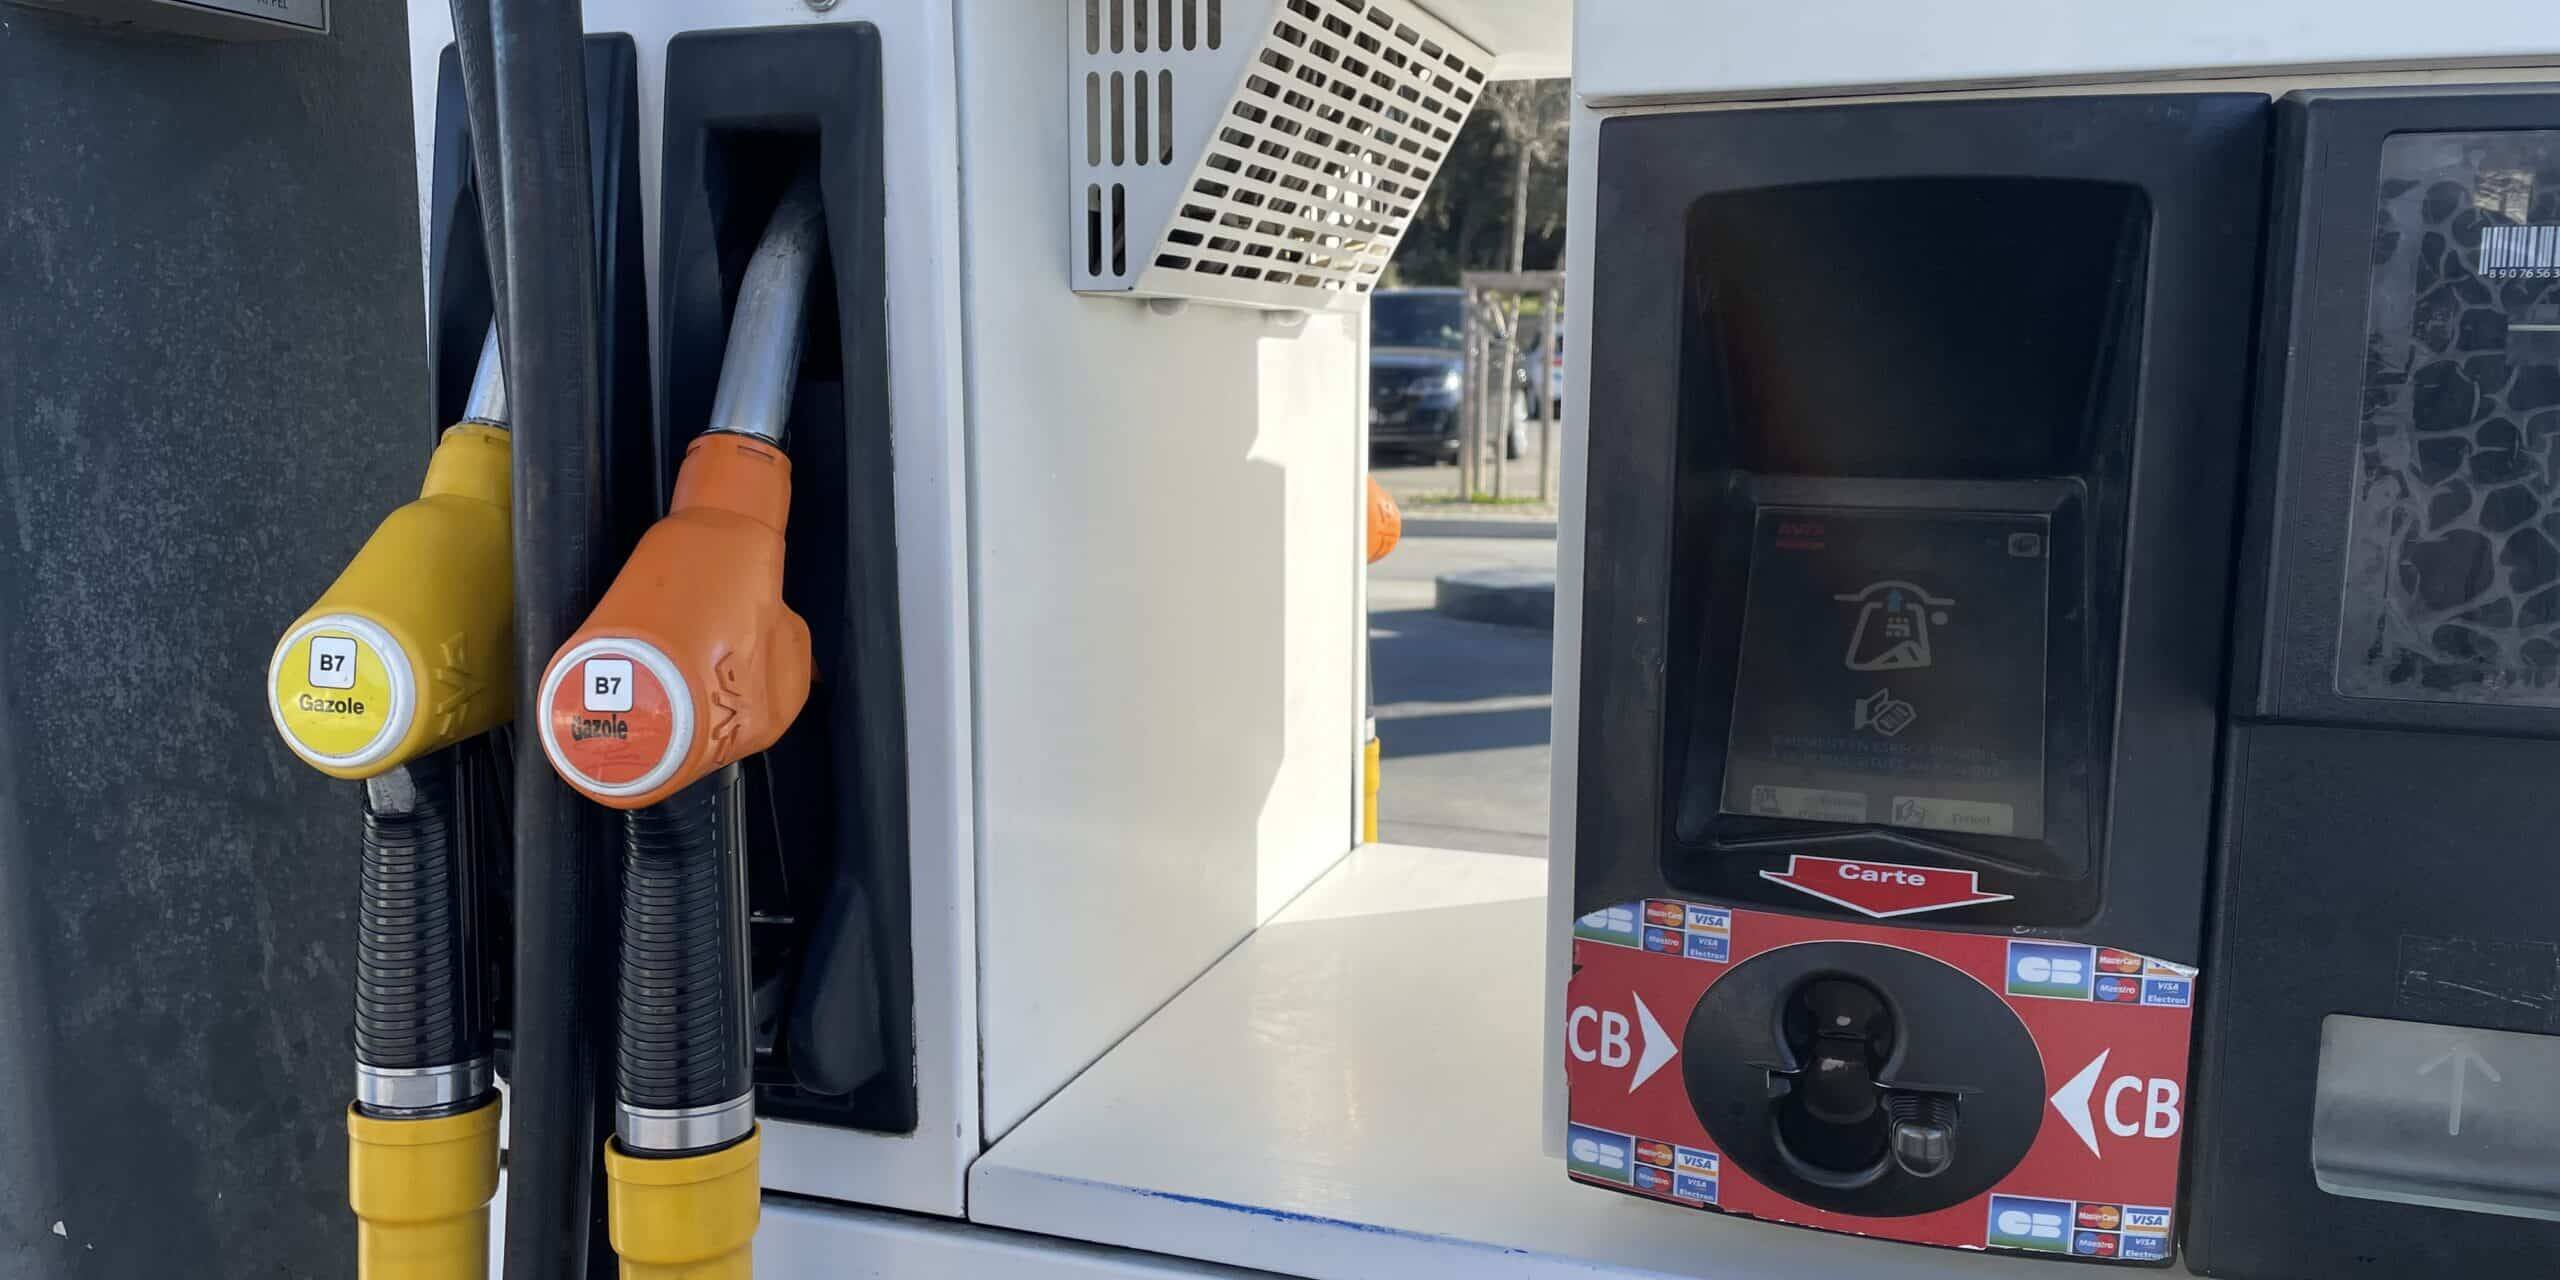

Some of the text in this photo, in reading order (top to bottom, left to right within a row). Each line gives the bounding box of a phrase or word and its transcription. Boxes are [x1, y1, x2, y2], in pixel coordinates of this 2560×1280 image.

[319, 654, 346, 673] B7
[594, 676, 622, 696] B7
[299, 693, 365, 716] Gazole
[570, 713, 629, 741] Gazole
[1838, 863, 1927, 887] Carte
[1695, 914, 1725, 927] VISA
[1698, 936, 1719, 947] VISA
[1690, 949, 1725, 960] Electron
[2100, 983, 2137, 995] Maestro
[2156, 981, 2180, 992] VISA
[2147, 994, 2187, 1005] Electron
[1568, 1005, 1632, 1069] CB
[2103, 1075, 2182, 1139] CB
[1683, 1155, 1713, 1171] VISA
[1687, 1176, 1708, 1188] VISA
[1679, 1187, 1715, 1201] Electron
[2131, 1214, 2164, 1227] VISA
[2079, 1238, 2115, 1250] Maestro
[2135, 1237, 2158, 1247] VISA
